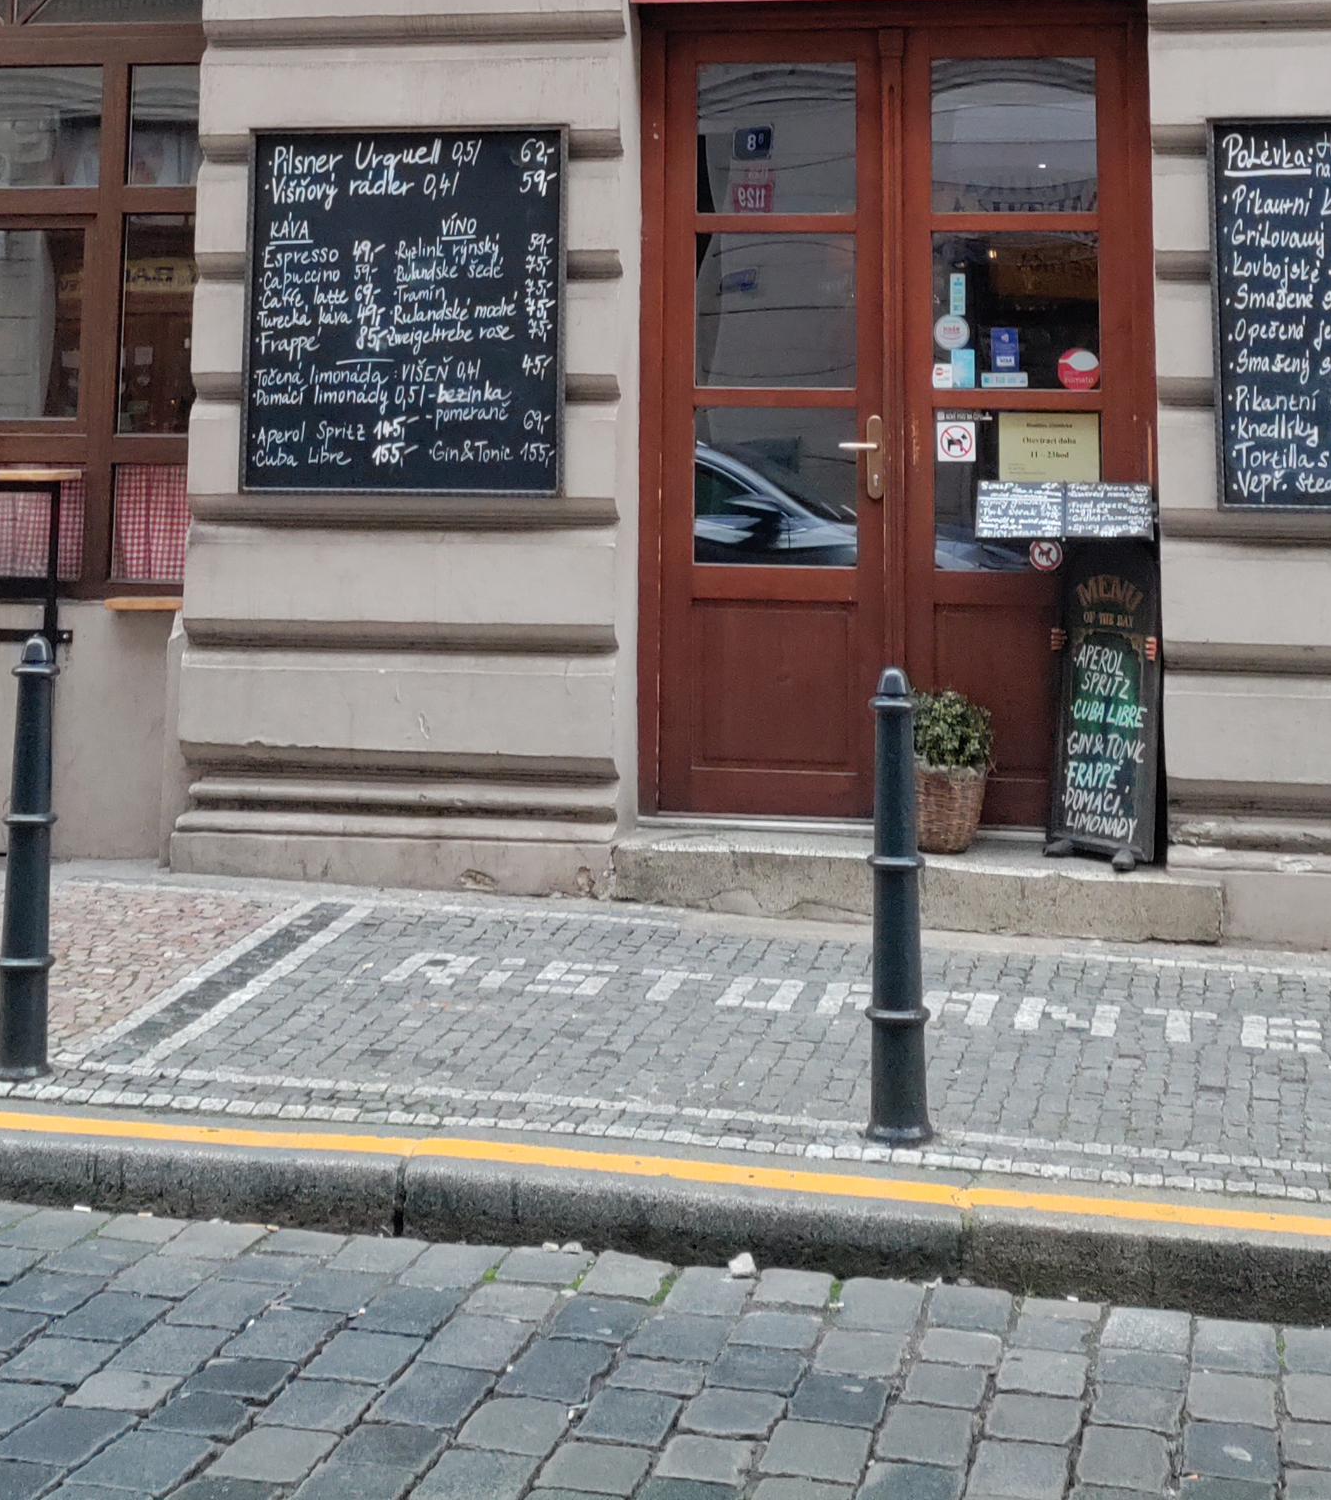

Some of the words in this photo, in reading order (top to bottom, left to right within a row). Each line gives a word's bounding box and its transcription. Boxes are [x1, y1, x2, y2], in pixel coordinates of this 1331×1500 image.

[273, 145, 343, 176] Pilsner
[355, 138, 442, 178] Urquell
[520, 138, 555, 165] 62,-
[1316, 161, 1330, 177] na
[272, 173, 338, 211] Višňový
[349, 169, 414, 197] rádler
[519, 169, 557, 197] 59,-
[1232, 184, 1313, 217] Pikantní
[270, 212, 309, 240] KÁVA
[441, 212, 477, 236] VÍNO
[1231, 218, 1325, 258] Grilovaný
[264, 246, 339, 274] Espresso
[352, 240, 385, 263] 49,-
[398, 236, 444, 265] Ryzlink
[453, 233, 499, 265] rýnský
[528, 233, 553, 254] 59,-
[264, 269, 340, 297] Capuccino
[354, 264, 378, 283] 59,-
[396, 256, 458, 283] Rulandské
[468, 257, 503, 278] šedé
[525, 256, 553, 276] 75,-
[1232, 251, 1321, 289] Kovbojské
[314, 285, 348, 305] latte
[355, 283, 381, 305] 69,-
[397, 285, 445, 303] Tramín
[525, 278, 553, 298] 75,-
[1234, 283, 1313, 310] Smažené
[259, 305, 311, 328] Turecká
[319, 305, 352, 326] káva
[357, 304, 385, 326] 49,-
[393, 298, 470, 324] Rulandské
[475, 291, 518, 319] modré
[525, 299, 555, 319] 75,-
[261, 327, 321, 361] Frappé
[356, 327, 388, 351] 85,-
[528, 319, 553, 343] 75,-
[1234, 316, 1306, 347] Opečená
[256, 362, 304, 387] Točená
[402, 356, 453, 382] VIŠEŇ
[522, 354, 553, 380] 45,-
[1236, 348, 1310, 385] Smažený
[256, 385, 308, 406] Domácí
[314, 384, 388, 415] limonády
[1236, 385, 1320, 412] Pikantní
[257, 421, 305, 451] Aperol
[317, 420, 365, 449] Spritz
[373, 416, 419, 440] 145,-
[524, 410, 551, 434] 69,-
[1237, 414, 1318, 447] Knedlíky
[256, 448, 298, 467] Cuba
[308, 446, 352, 465] Libre
[372, 442, 418, 468] 155,-
[520, 443, 555, 468] 155,-
[1234, 441, 1315, 469] Tortilla
[1318, 450, 1329, 468] s
[1076, 574, 1144, 611] MENU
[1083, 611, 1095, 624] OF
[1099, 612, 1114, 625] THE
[1116, 614, 1134, 628] DAY
[1076, 644, 1124, 676] APEROL
[1081, 671, 1130, 700] SPRITZ
[1074, 698, 1105, 723] CUBA
[1106, 703, 1148, 729] LIBRE
